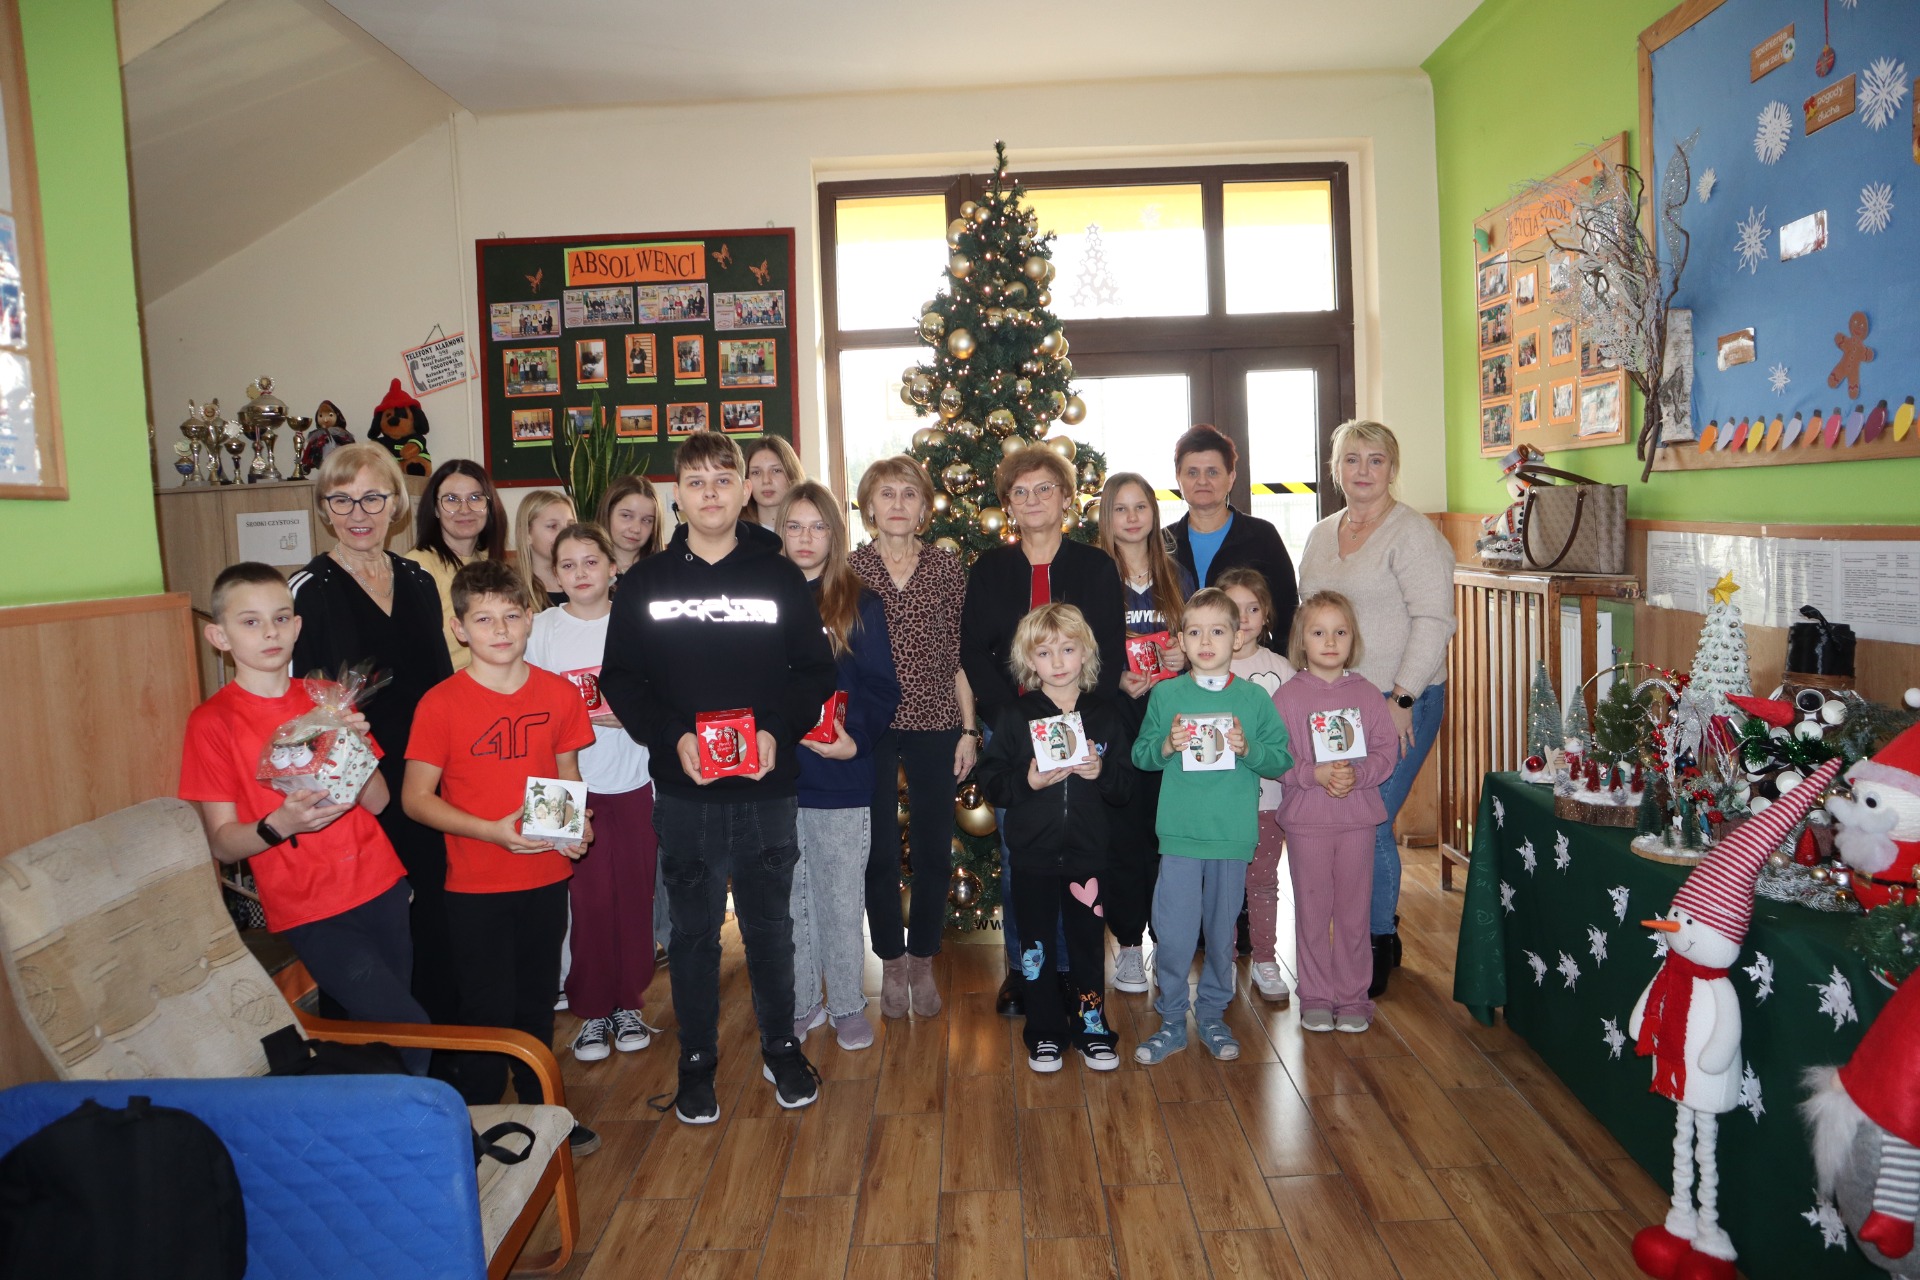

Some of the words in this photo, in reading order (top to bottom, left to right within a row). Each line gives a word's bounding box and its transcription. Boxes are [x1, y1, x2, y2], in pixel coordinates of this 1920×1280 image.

[1817, 85, 1844, 106] pogody
[1817, 105, 1840, 122] ducha
[571, 249, 697, 279] ABSOLWENCI
[405, 347, 433, 361] TELEFONY
[435, 336, 465, 351] ALARMOWE
[430, 358, 459, 371] POGOTOWIA
